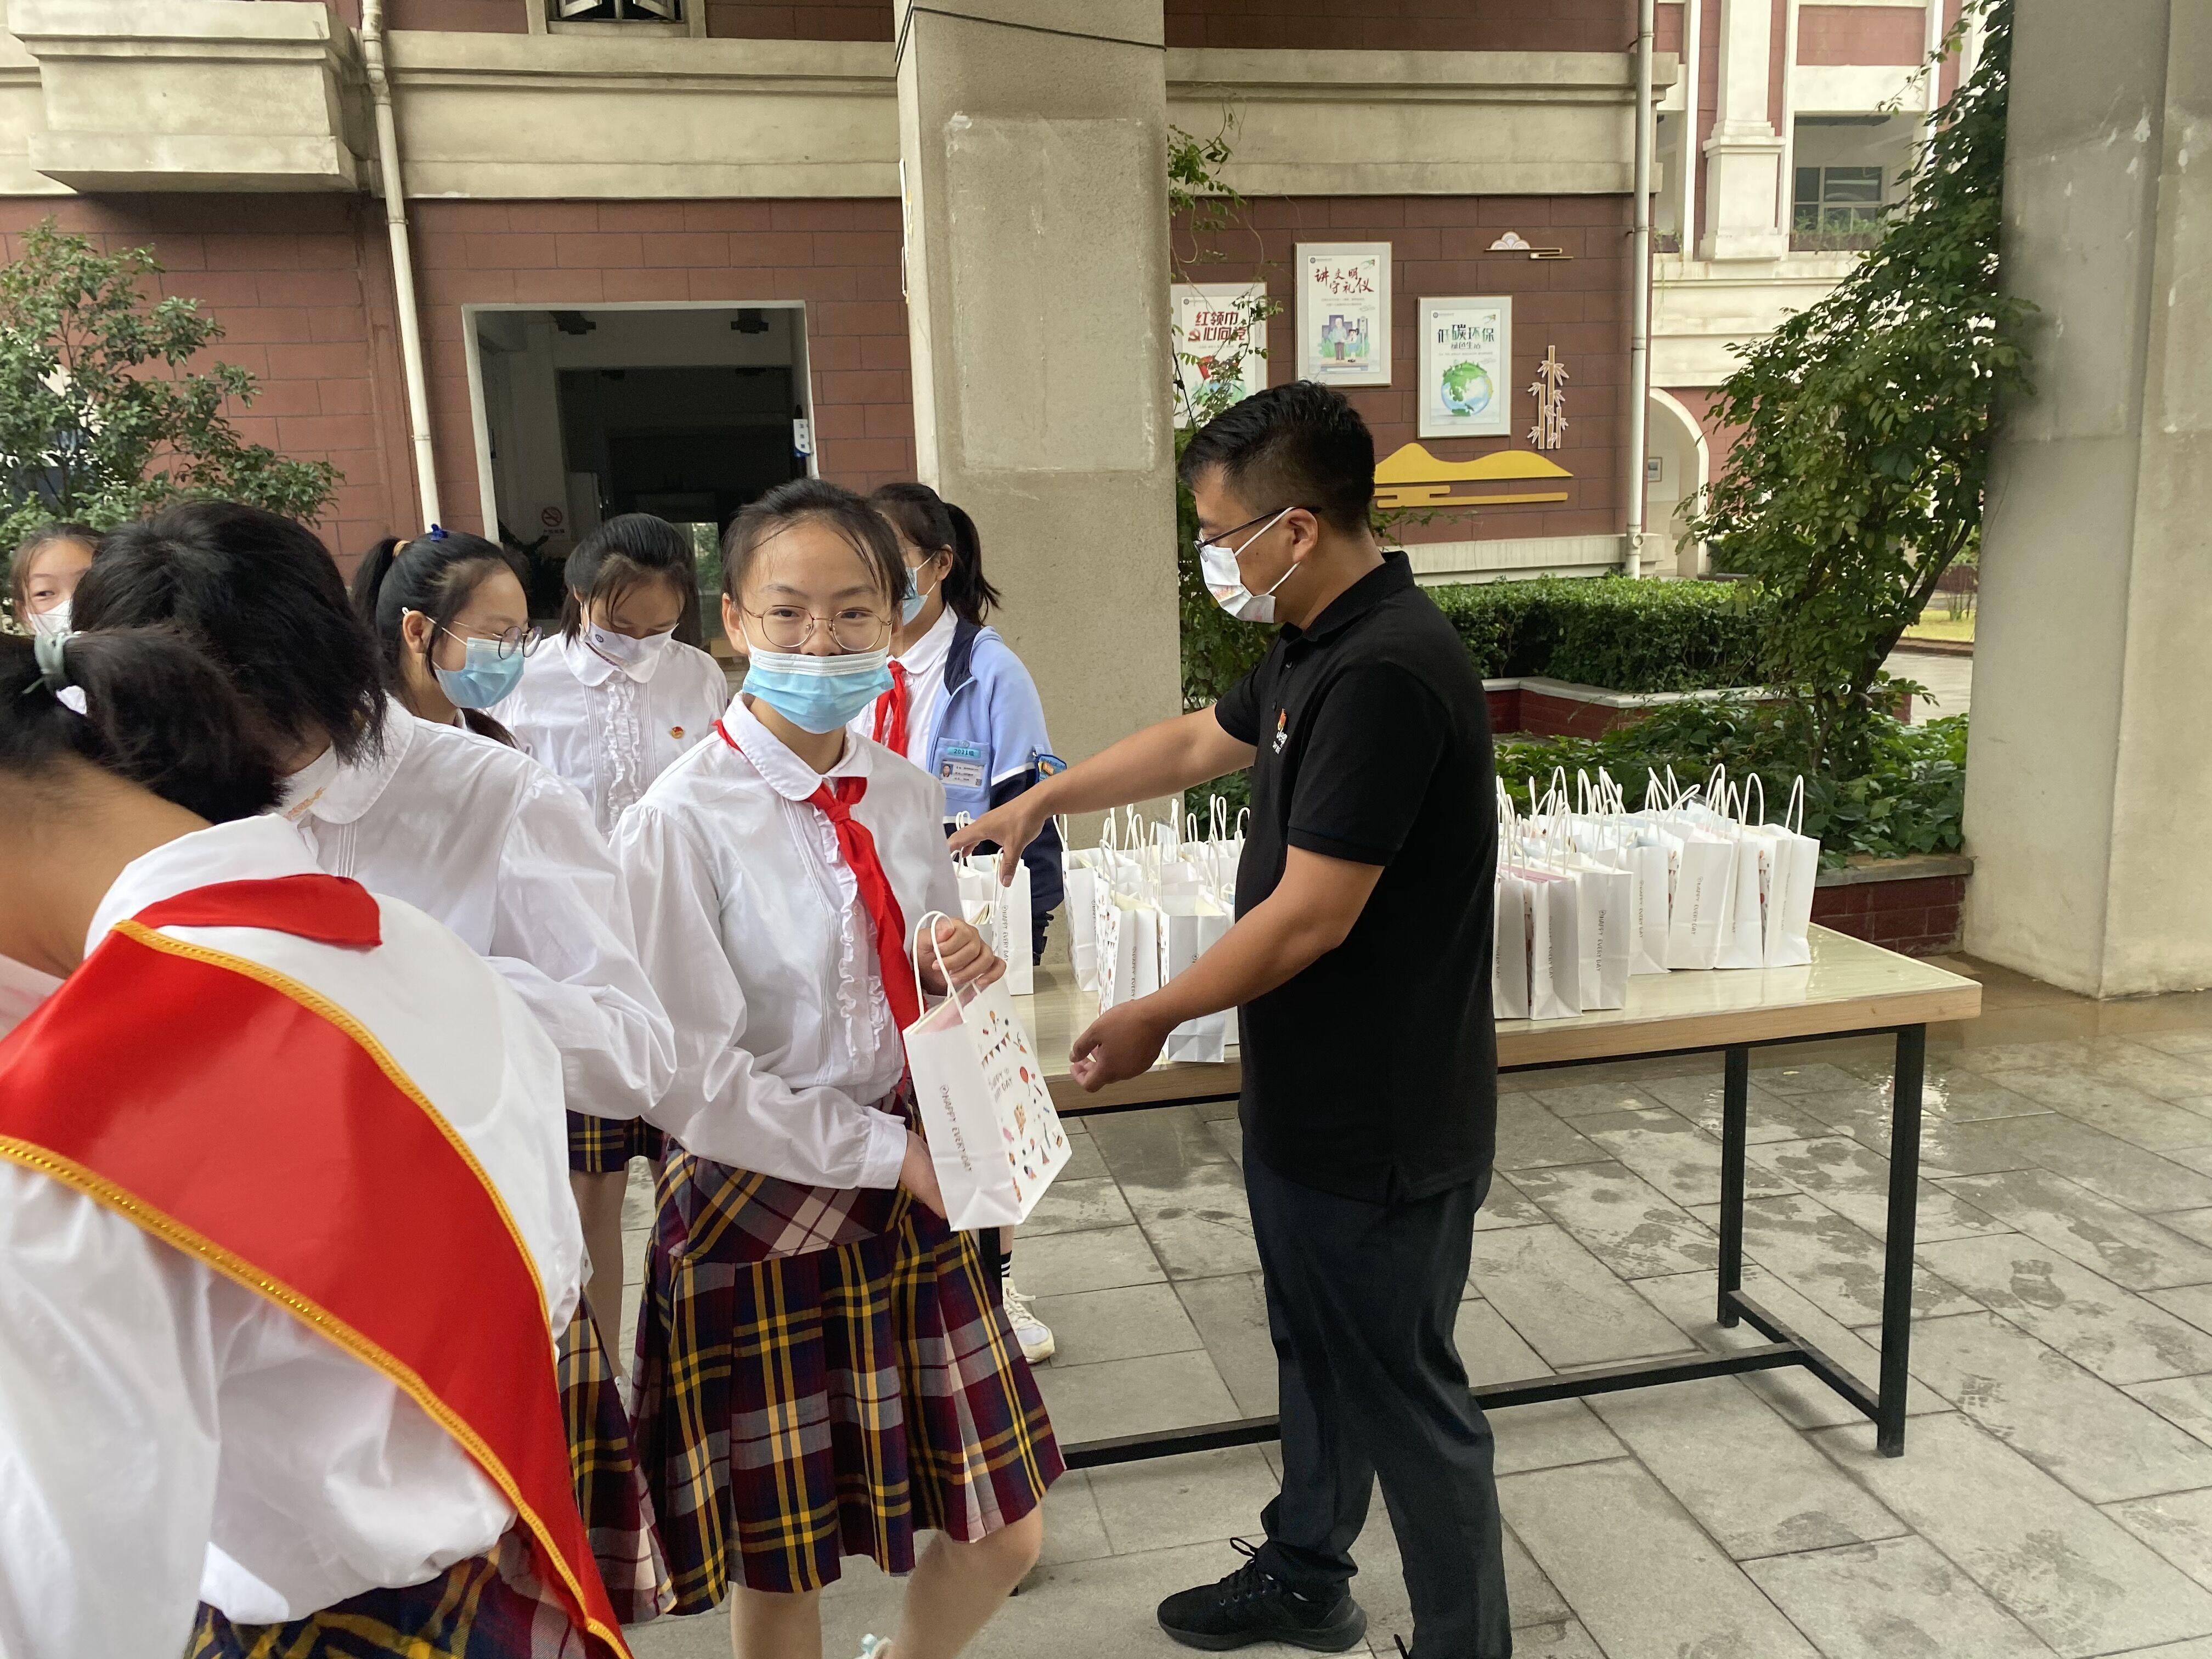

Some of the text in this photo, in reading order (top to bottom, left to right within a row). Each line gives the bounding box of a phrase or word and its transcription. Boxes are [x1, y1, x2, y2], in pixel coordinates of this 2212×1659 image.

[1314, 267, 1358, 286] 讲文明
[1329, 278, 1374, 294] 守礼仪
[1195, 312, 1239, 326] 红领巾
[1437, 324, 1494, 343] 低碳环保
[1001, 1076, 1013, 1092] DAY
